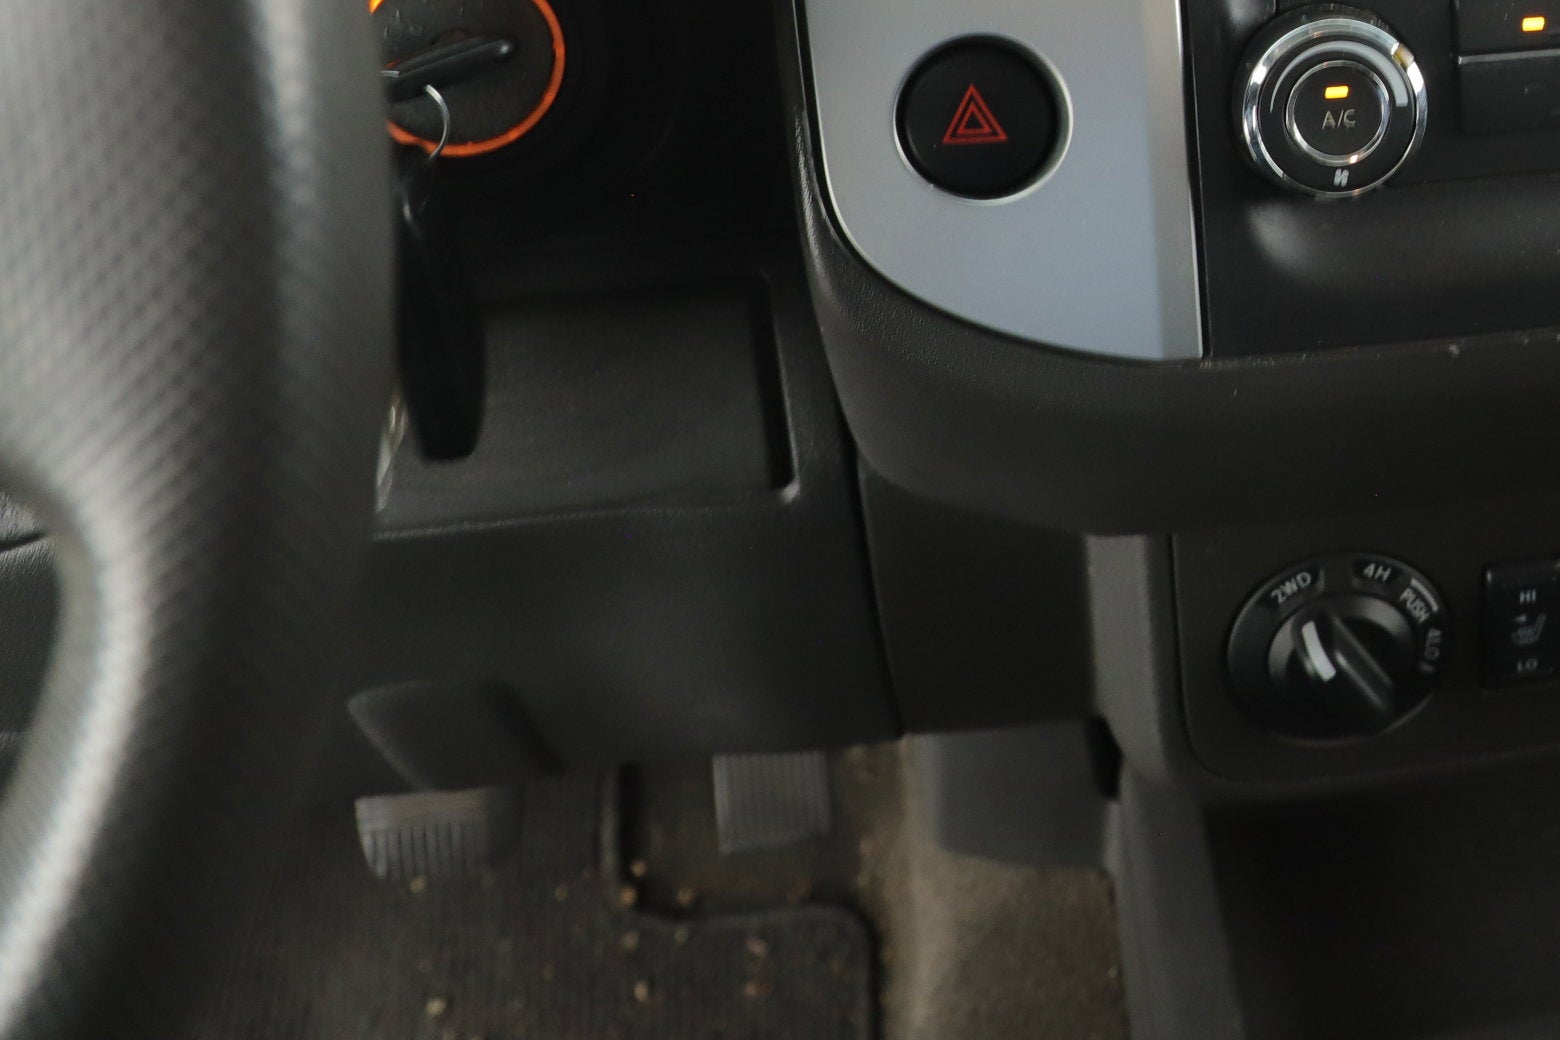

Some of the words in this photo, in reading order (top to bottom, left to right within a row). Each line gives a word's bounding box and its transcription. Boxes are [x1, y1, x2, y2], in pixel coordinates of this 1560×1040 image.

[1322, 109, 1355, 130] A/C
[1363, 561, 1393, 584] 4H
[1271, 571, 1313, 605] 2WD
[1519, 589, 1536, 604] HI
[1400, 587, 1430, 624] PUSH
